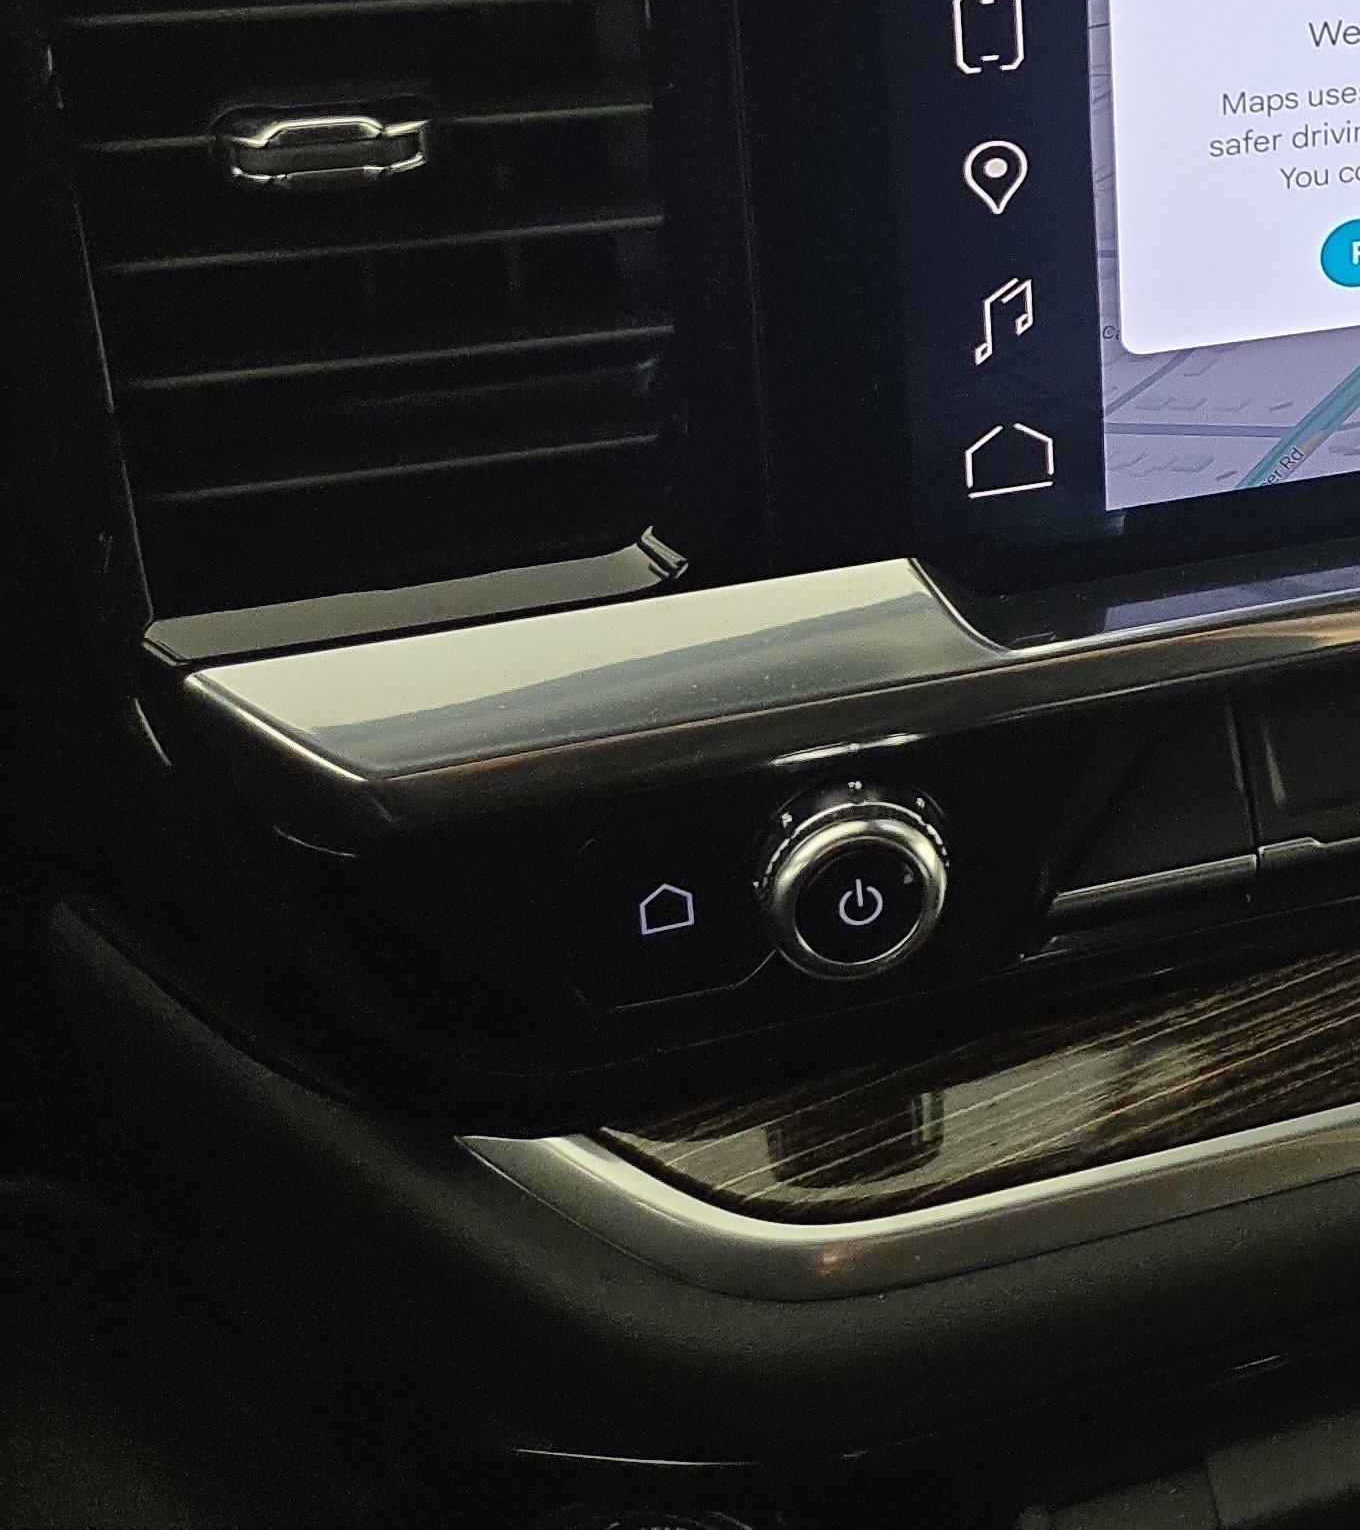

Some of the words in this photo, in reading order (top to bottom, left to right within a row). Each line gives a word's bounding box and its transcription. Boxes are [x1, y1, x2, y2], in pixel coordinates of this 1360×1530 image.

[1221, 90, 1299, 118] Maps
[1209, 129, 1283, 157] safer
[1280, 166, 1329, 190] You
[1279, 446, 1304, 471] Rd
